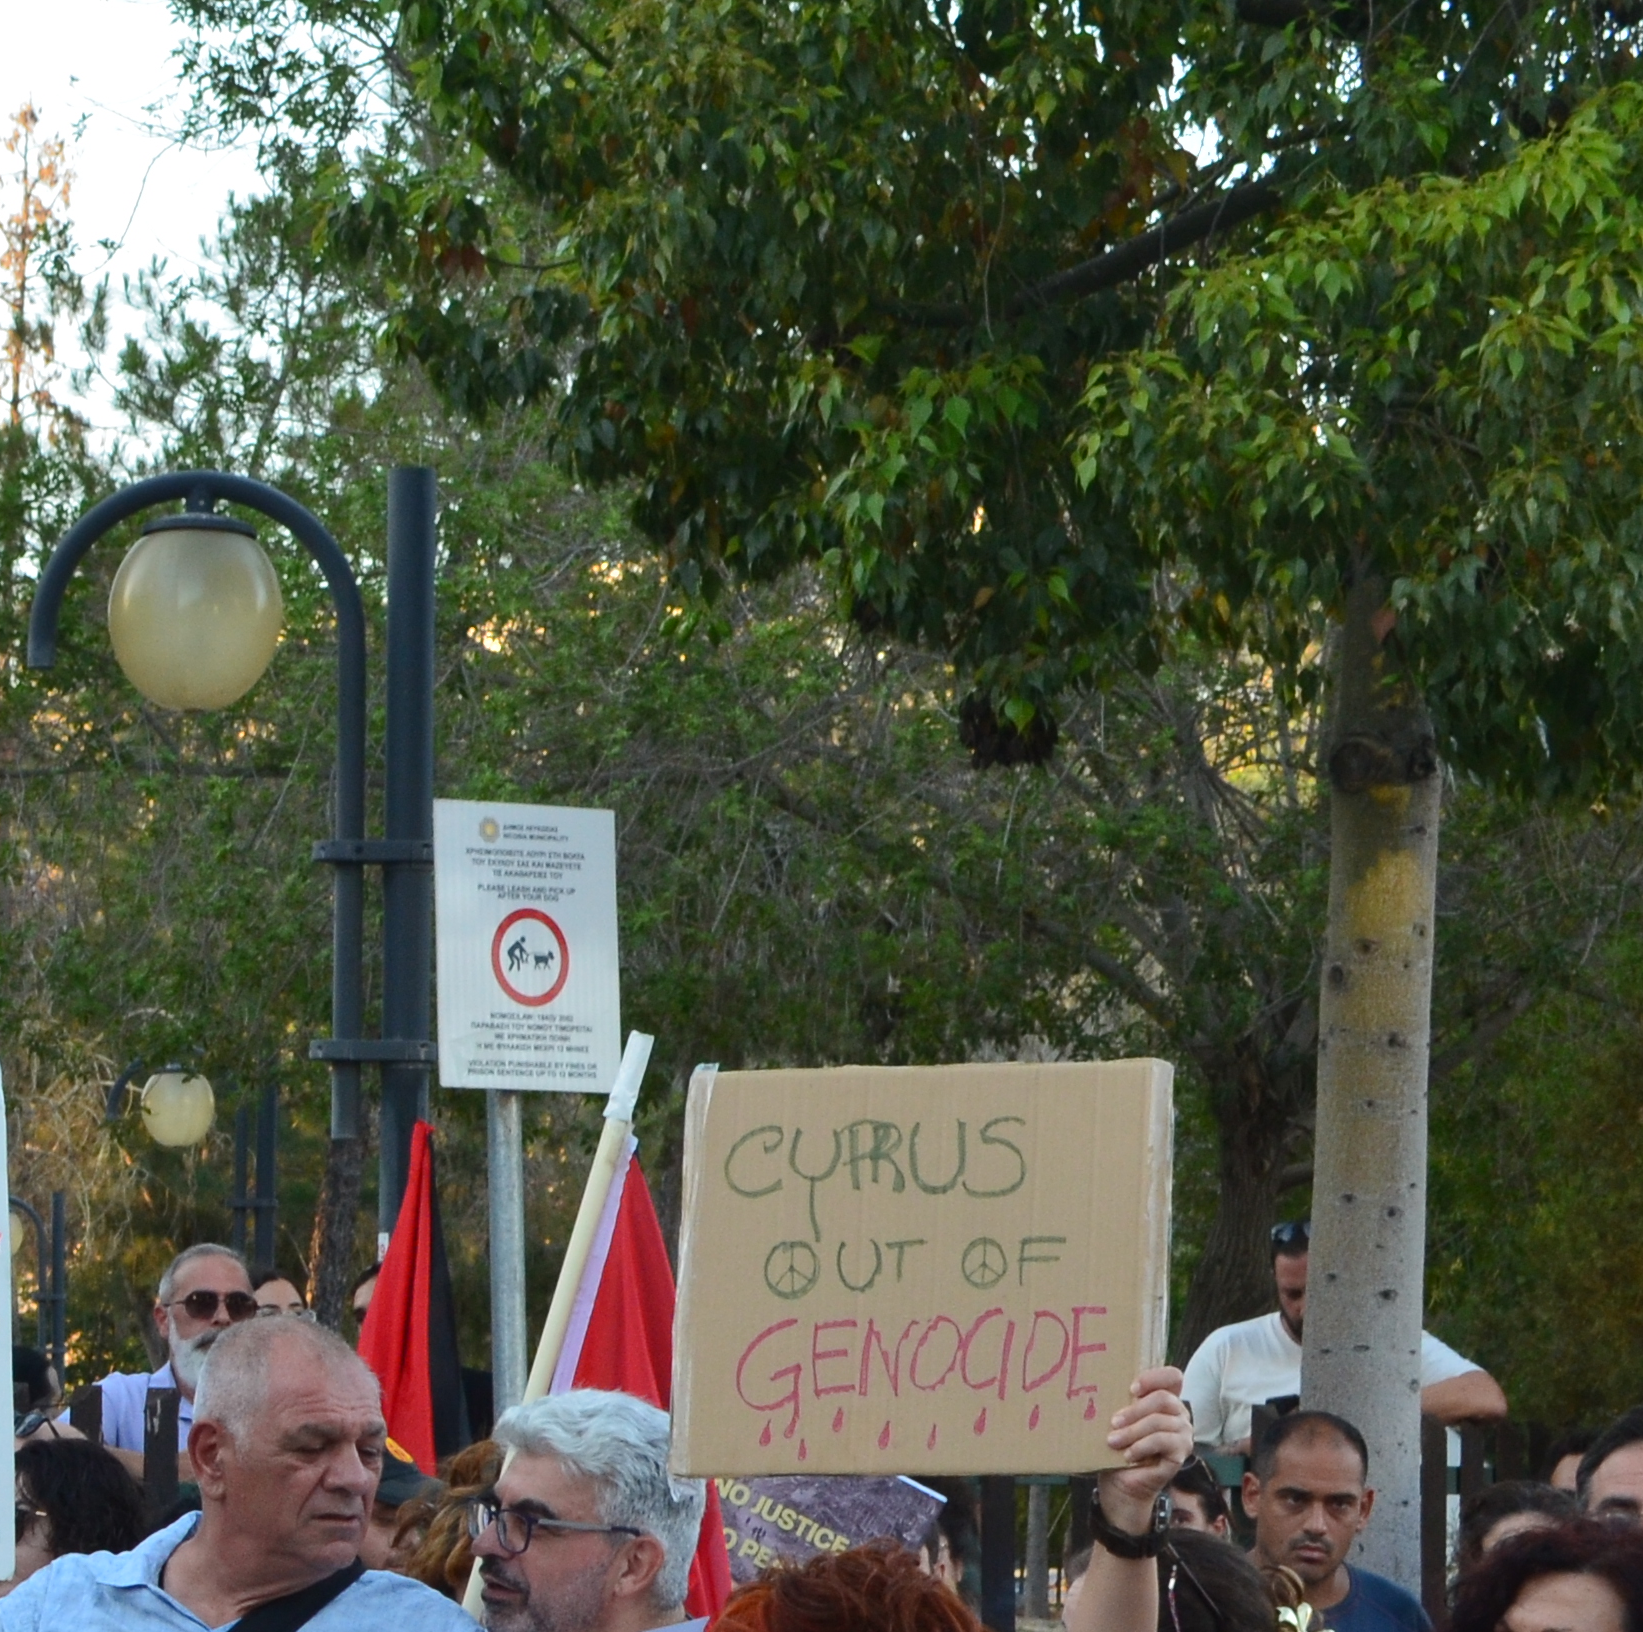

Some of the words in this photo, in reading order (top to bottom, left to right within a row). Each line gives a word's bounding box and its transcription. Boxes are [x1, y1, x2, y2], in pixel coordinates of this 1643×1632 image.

[723, 1116, 1028, 1243] CYPRUS
[763, 1239, 928, 1300] OUT
[960, 1236, 1067, 1289] OF
[735, 1305, 1108, 1412] GENOCIDE
[715, 1478, 751, 1507] NO
[750, 1495, 851, 1554] JUSTICE
[723, 1527, 739, 1549] O
